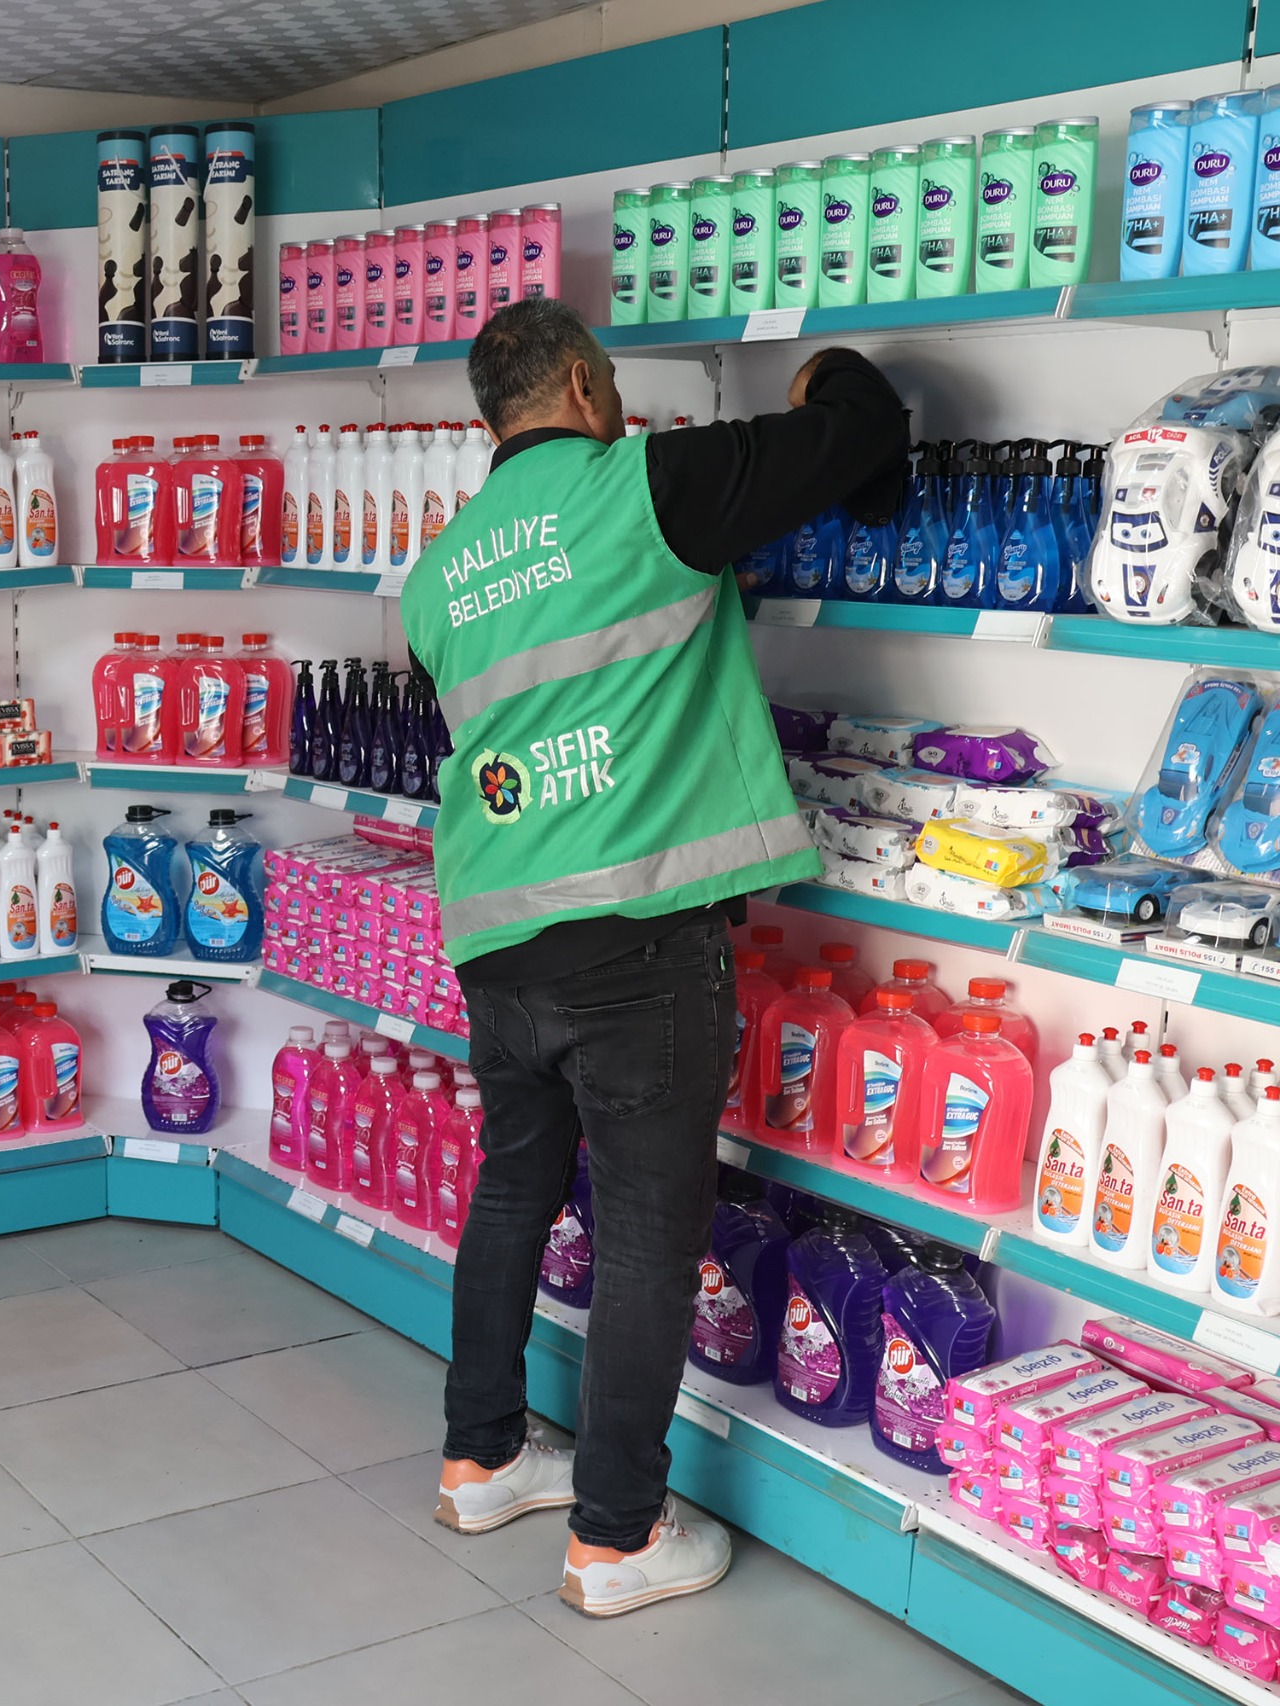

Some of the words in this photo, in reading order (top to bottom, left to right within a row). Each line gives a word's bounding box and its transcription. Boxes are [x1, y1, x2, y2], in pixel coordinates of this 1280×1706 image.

[1198, 159, 1225, 169] DURU
[1132, 168, 1158, 178] DURU
[1044, 179, 1070, 188] DURU
[1199, 179, 1218, 187] NEM
[984, 187, 1008, 197] DURU
[925, 194, 947, 204] DURU
[873, 201, 895, 210] DURU
[826, 208, 847, 217] DURU
[734, 221, 751, 229] DURU
[780, 215, 799, 224] DURU
[653, 232, 670, 240] DURU
[694, 226, 712, 235] DURU
[1147, 428, 1163, 439] 112
[442, 514, 558, 592] HALİLİYE
[448, 548, 572, 628] BELEDİYESİ
[530, 726, 613, 772] SIFIR
[540, 757, 615, 809] ATIK
[116, 871, 133, 886] pür
[200, 876, 217, 891] pür
[1051, 922, 1071, 930] İMDAT
[1073, 926, 1092, 934] POLİS
[1155, 944, 1178, 955] İMDAT
[1180, 949, 1202, 959] POLİS
[1204, 954, 1216, 962] 155
[162, 1056, 178, 1072] pür
[1052, 1179, 1082, 1192] DETERJANI
[1104, 1195, 1131, 1210] DETERJANI
[1167, 1217, 1200, 1231] DETERJANI
[1230, 1239, 1262, 1254] DETERJANI
[702, 1270, 721, 1290] pür
[790, 1304, 808, 1324] pür
[889, 1345, 911, 1369] pür
[1013, 1355, 1062, 1378] gizlady
[1070, 1378, 1119, 1402] gizlady
[1122, 1399, 1174, 1422] gizlady
[1174, 1425, 1226, 1446] gizlady
